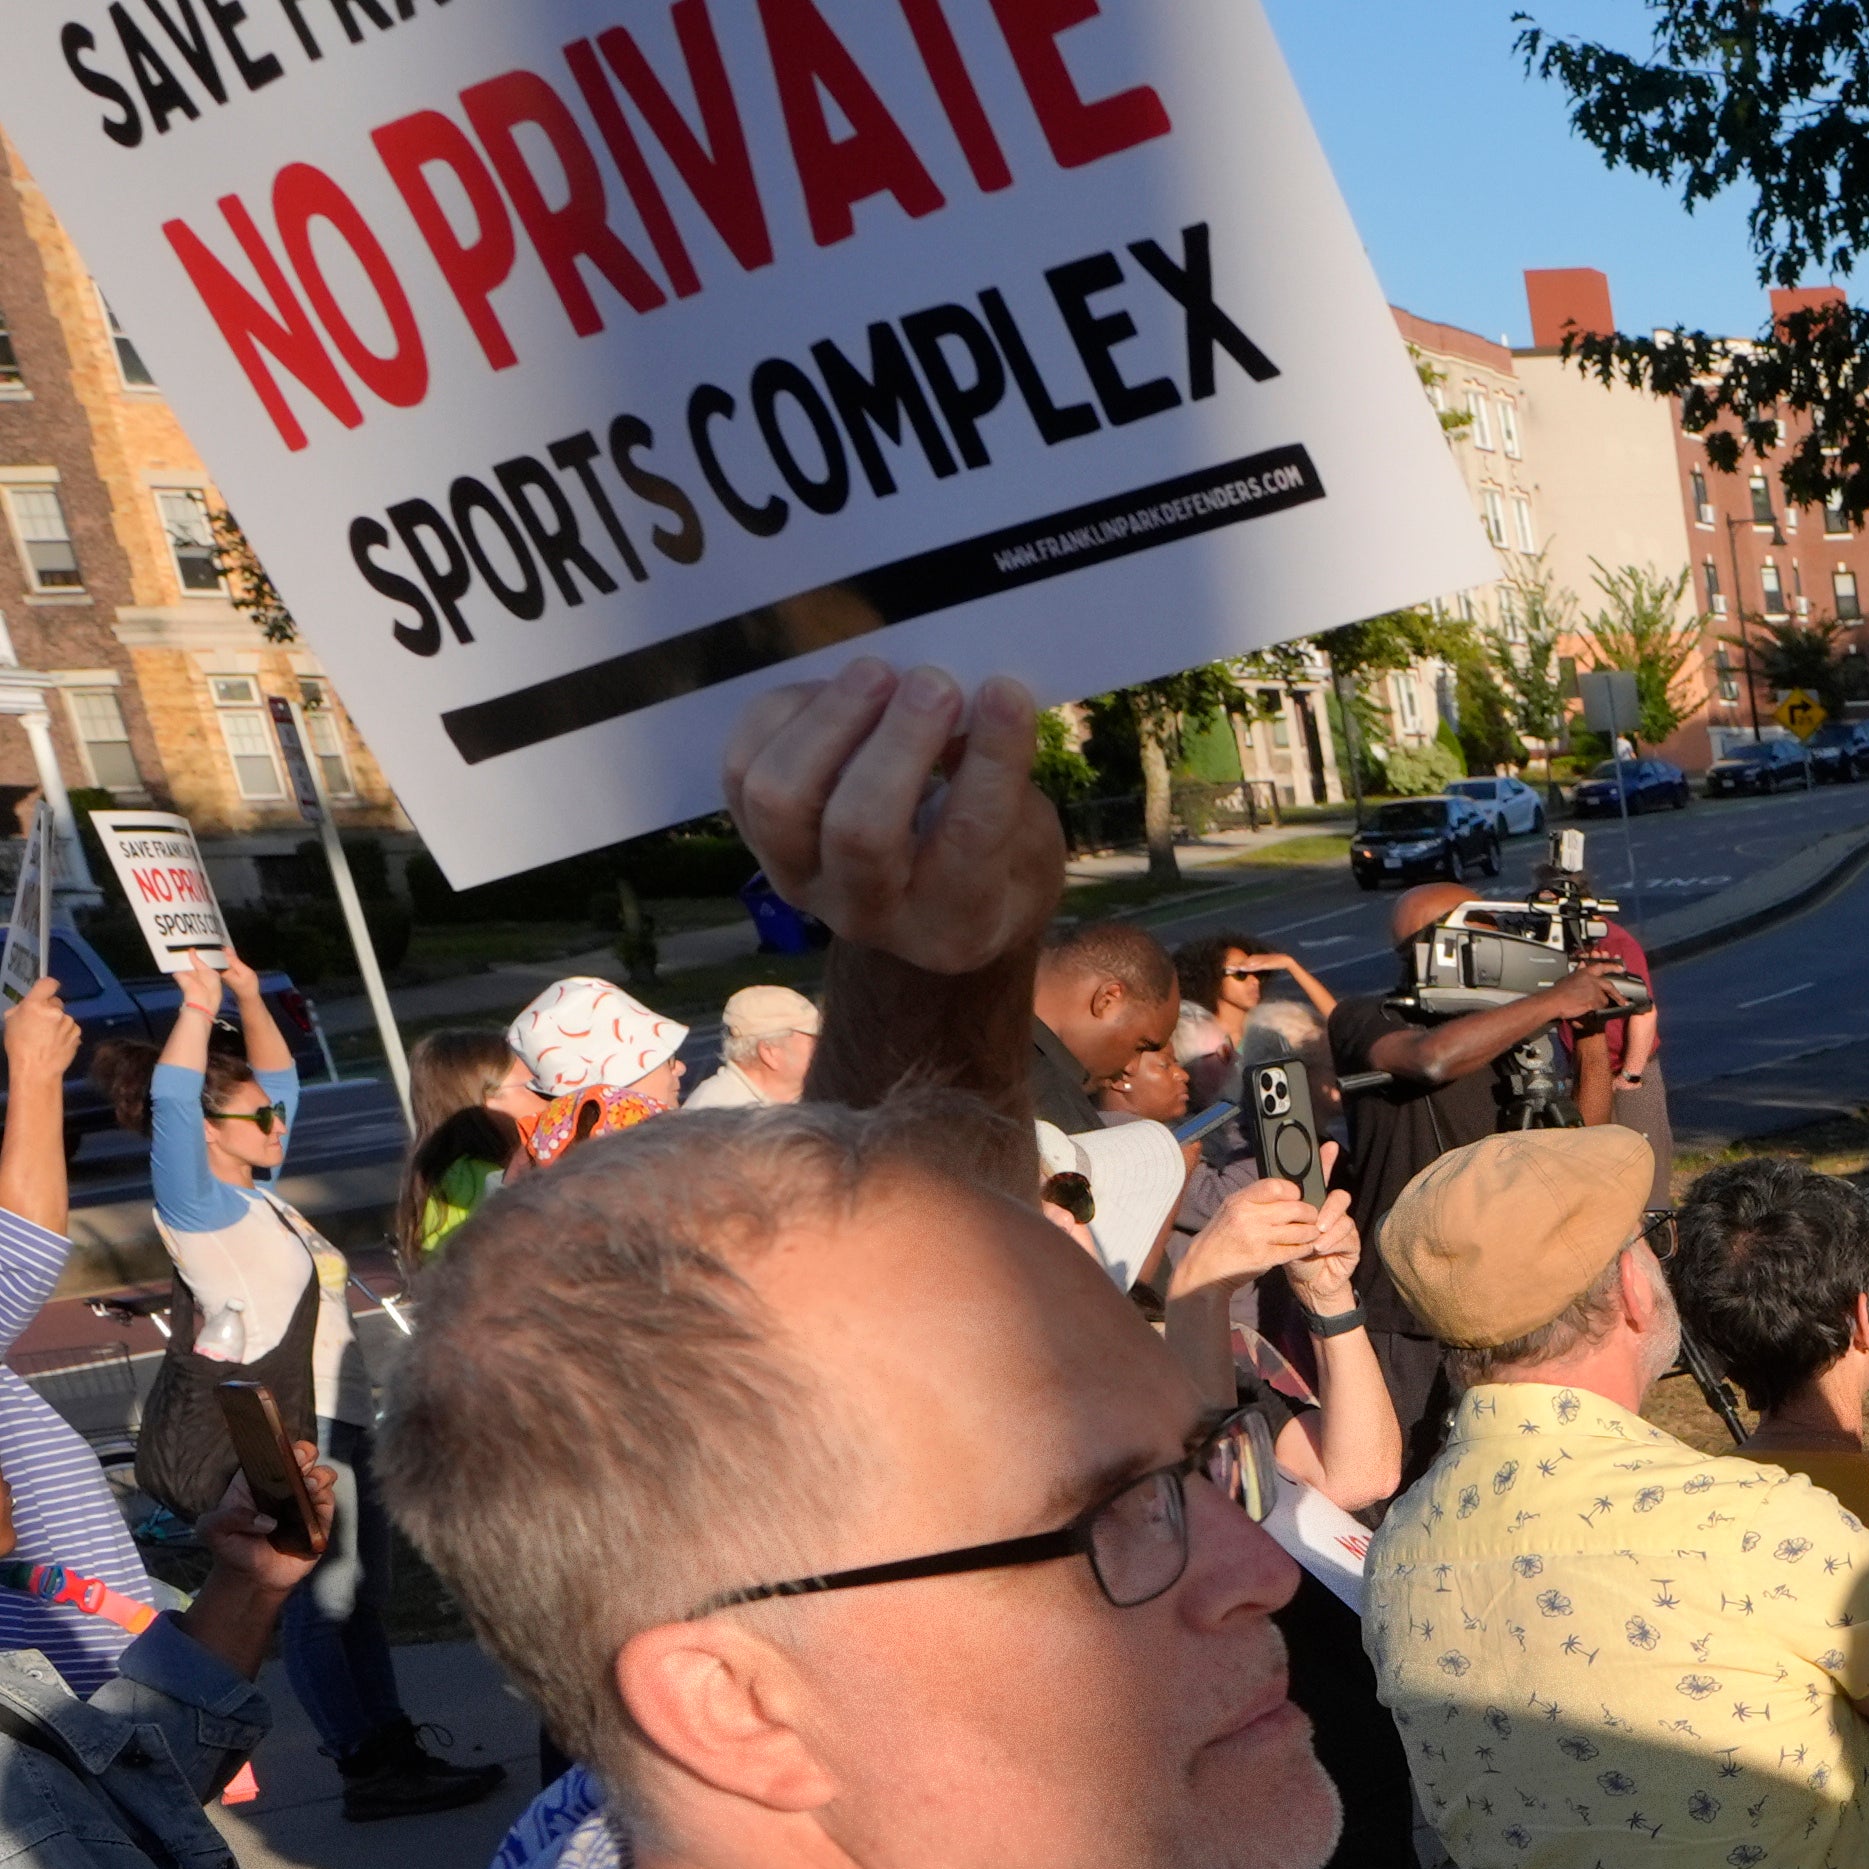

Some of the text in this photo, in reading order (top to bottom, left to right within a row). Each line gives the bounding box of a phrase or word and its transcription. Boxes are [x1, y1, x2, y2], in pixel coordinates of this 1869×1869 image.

[162, 162, 430, 452] NO
[349, 222, 1281, 657] SPORTS COMPLEX
[993, 464, 1304, 573] WWW.FRANKLINPARKDEFENDERS.COM
[119, 840, 154, 859] SAVE
[131, 867, 174, 904] NO
[153, 913, 208, 938] SPORTS
